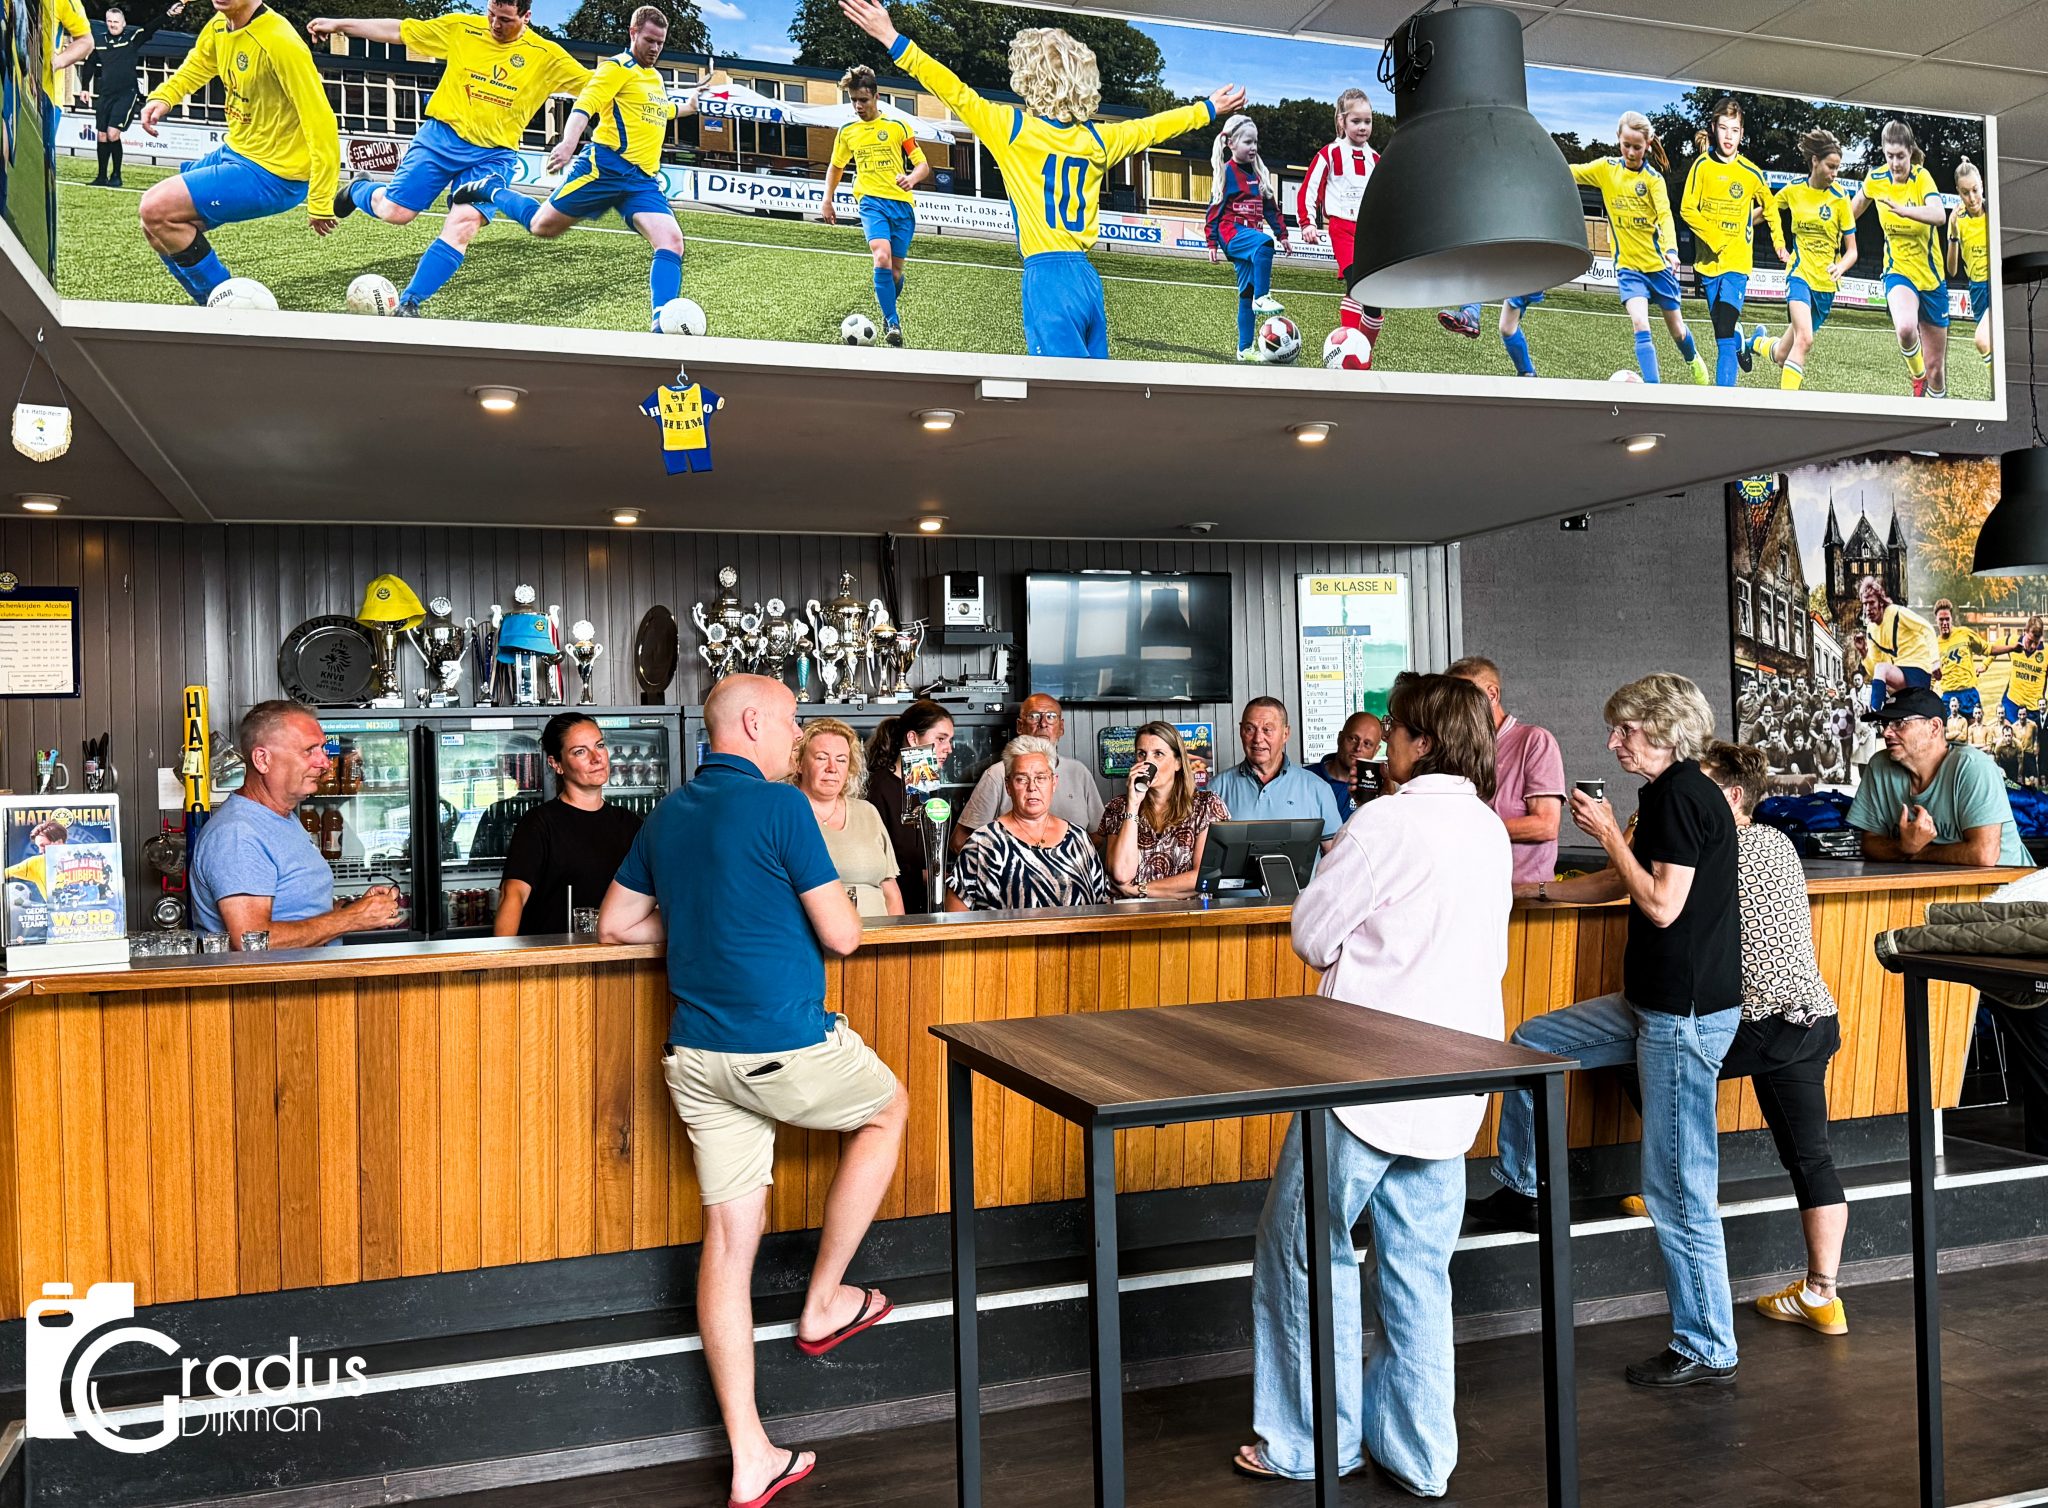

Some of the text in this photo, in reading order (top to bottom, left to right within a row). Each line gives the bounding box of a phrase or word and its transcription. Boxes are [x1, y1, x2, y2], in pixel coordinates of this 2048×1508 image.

[145, 141, 169, 149] HEUTINK
[352, 141, 393, 161] GEWOON
[1042, 154, 1089, 231] 10
[955, 203, 977, 215] Tel.
[920, 213, 1015, 230] www.dispomedi
[1099, 225, 1158, 242] RONICS
[1588, 262, 1617, 279] ebo.nl
[670, 392, 687, 402] SV
[1315, 580, 1392, 592] 3e KLASSE N
[320, 670, 345, 681] KNVB
